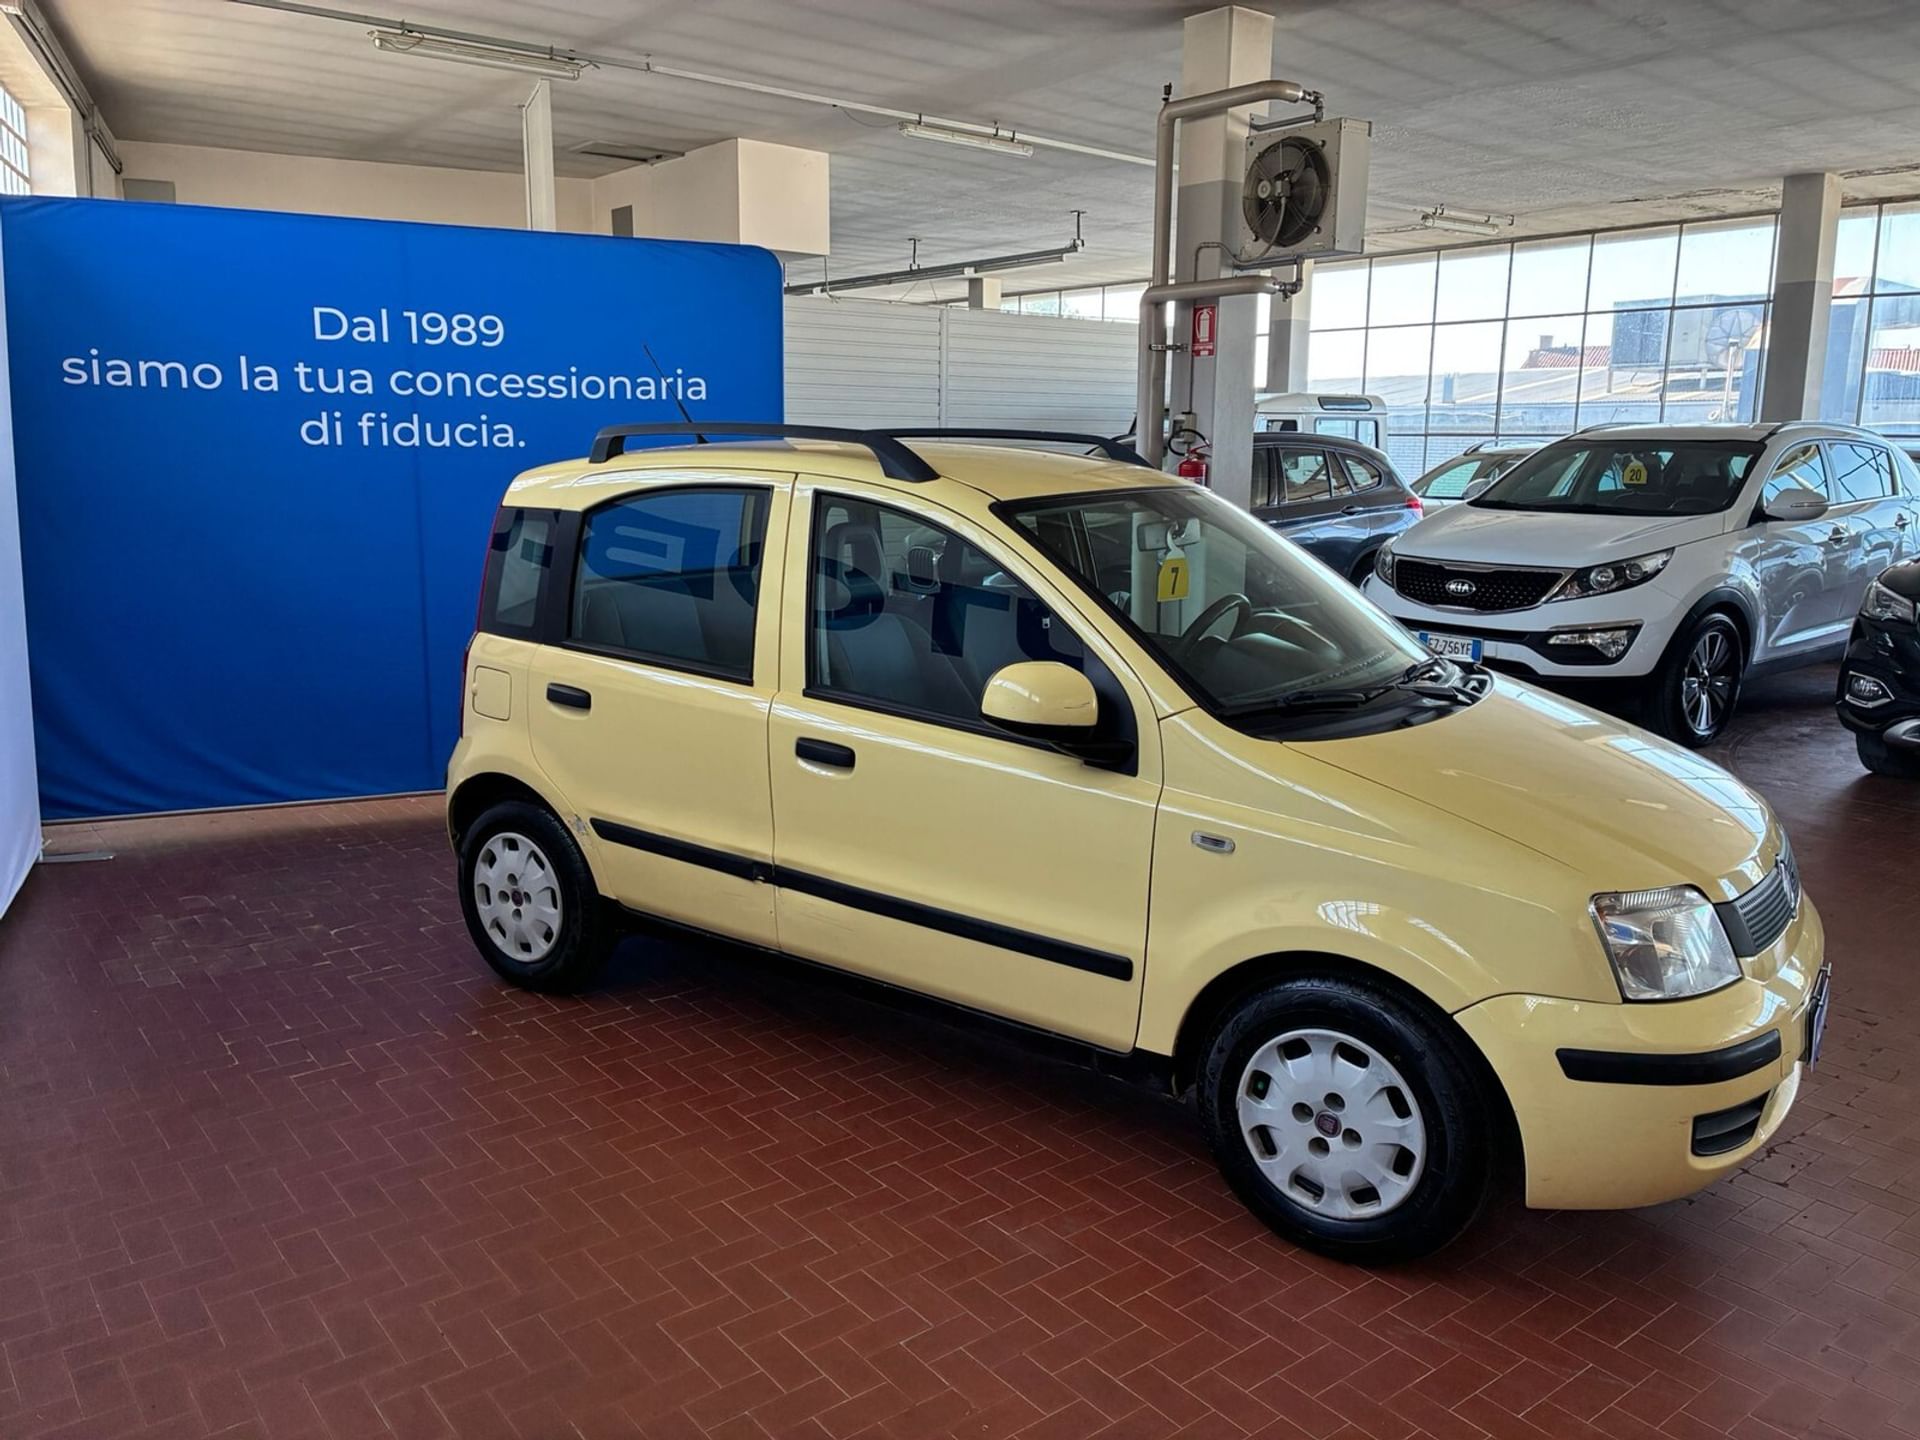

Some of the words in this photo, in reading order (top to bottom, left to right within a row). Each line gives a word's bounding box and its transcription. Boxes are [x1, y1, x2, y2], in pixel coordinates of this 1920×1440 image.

[313, 306, 389, 343] Dal
[403, 310, 504, 347] 1989
[62, 348, 223, 390] siamo
[239, 355, 279, 392] la
[294, 362, 374, 394] tua
[389, 366, 707, 401] concessionaria
[300, 411, 343, 446] di
[357, 412, 526, 448] fiducia.
[1629, 468, 1642, 482] 20
[1171, 566, 1179, 595] 7
[1449, 582, 1469, 593] KIA
